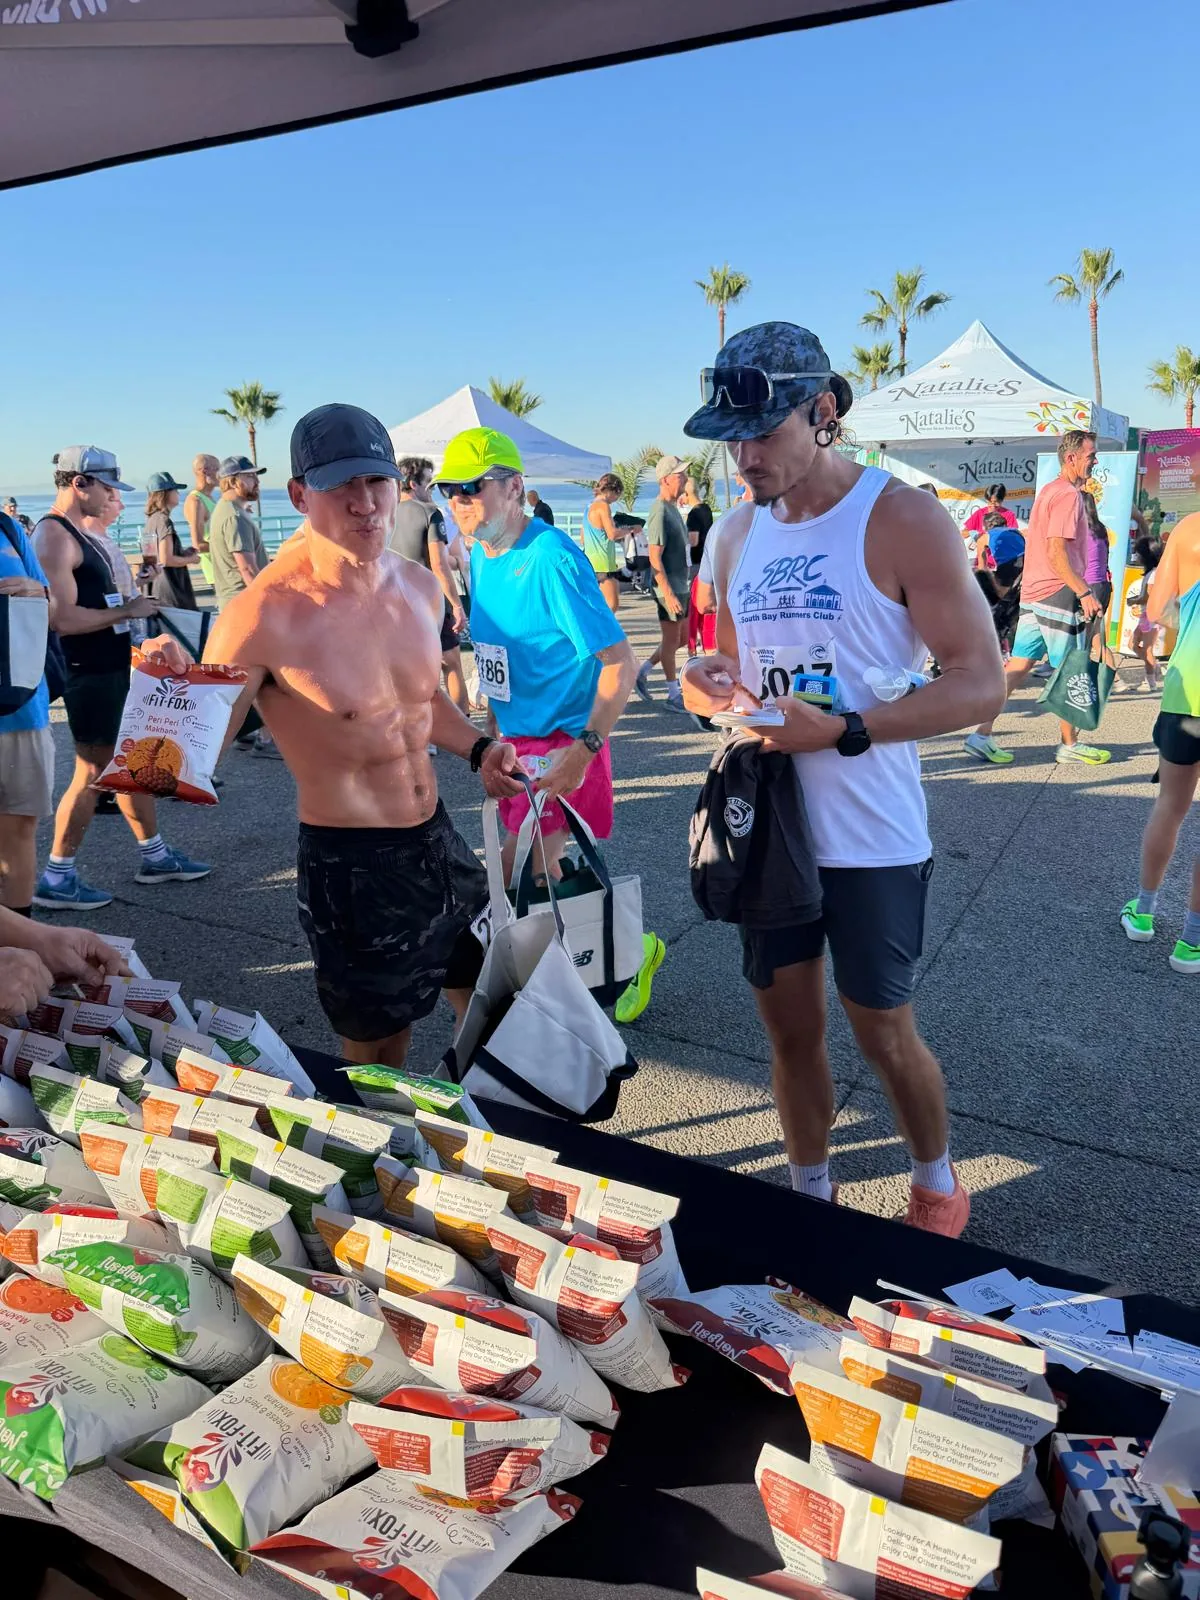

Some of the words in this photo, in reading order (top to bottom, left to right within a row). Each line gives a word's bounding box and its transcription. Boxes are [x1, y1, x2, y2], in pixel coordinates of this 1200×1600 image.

[756, 555, 828, 591] SBRC
[741, 614, 760, 623] South
[762, 613, 777, 621] Bay
[813, 611, 834, 619] Club
[148, 715, 162, 724] Peri
[164, 717, 180, 727] Peri
[145, 724, 177, 736] Makhana
[952, 1348, 973, 1358] Looking
[954, 1396, 979, 1409] Looking
[999, 1411, 1023, 1422] Healthy
[1024, 1417, 1038, 1425] And
[957, 1405, 986, 1418] Delicious
[953, 1412, 969, 1422] Enjoy
[985, 1421, 1003, 1431] Other
[1005, 1427, 1035, 1440] Flavours!
[915, 1427, 941, 1442] Looking
[942, 1437, 953, 1445] For
[961, 1443, 988, 1457] Healthy
[989, 1453, 1003, 1462] And
[918, 1437, 948, 1452] Delicious
[913, 1444, 931, 1456] Enjoy
[933, 1451, 945, 1459] Our
[946, 1456, 966, 1467] Other
[968, 1463, 999, 1478] Flavours!
[424, 1508, 449, 1524] Thai
[883, 1524, 911, 1540] Looking
[912, 1535, 924, 1544] For
[933, 1542, 960, 1558] Healthy
[962, 1554, 977, 1564] And
[887, 1536, 918, 1552] Delicious
[882, 1543, 901, 1556] Enjoy
[903, 1551, 916, 1561] Our
[917, 1557, 938, 1570] Other
[940, 1565, 973, 1580] Flavours!
